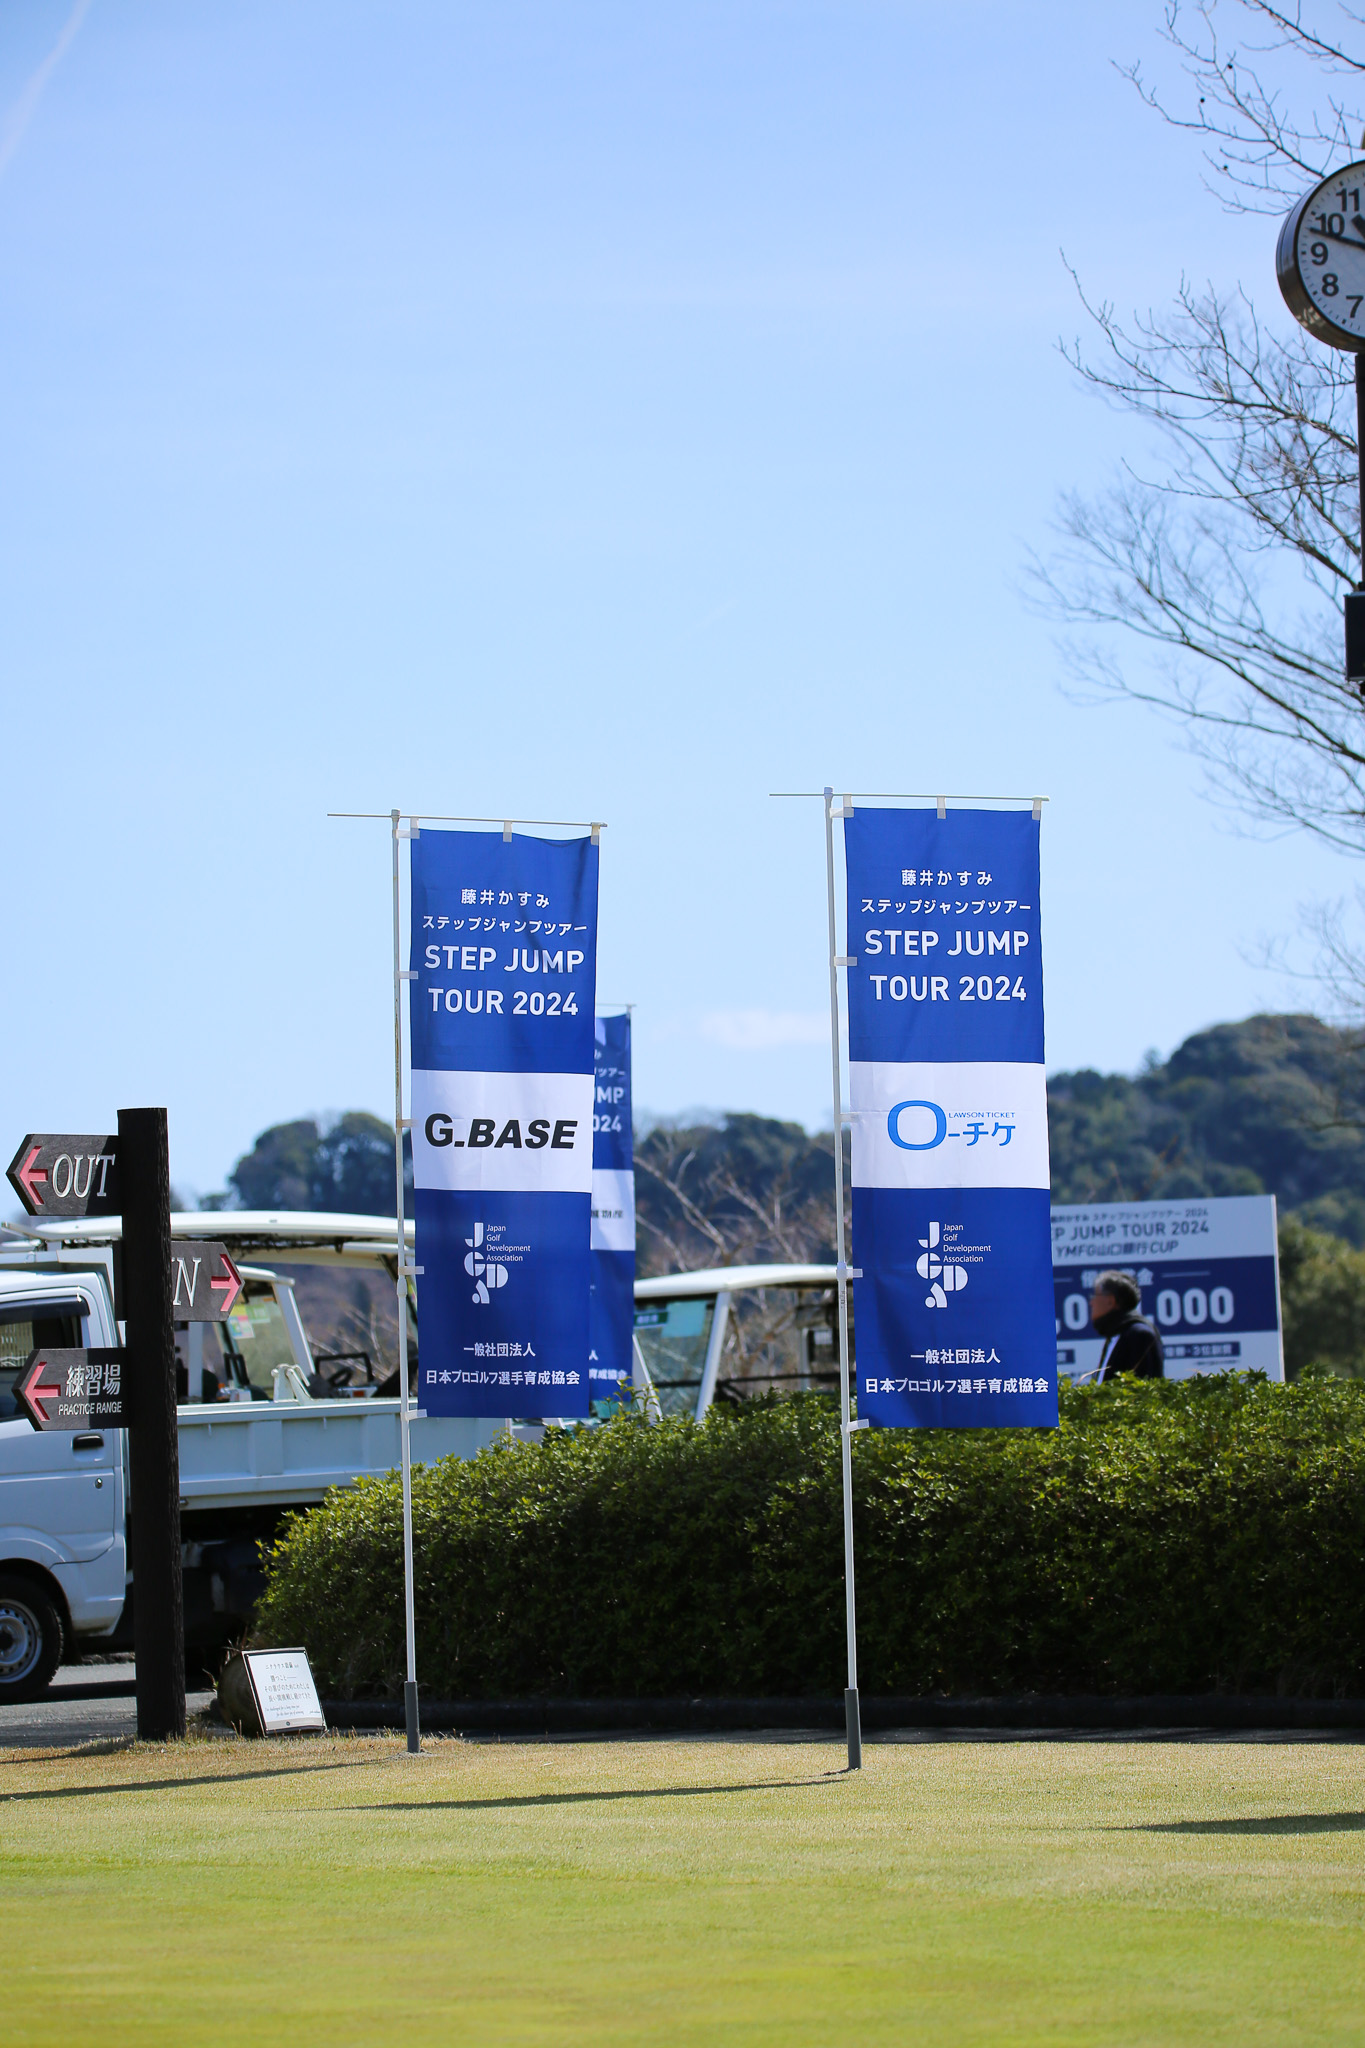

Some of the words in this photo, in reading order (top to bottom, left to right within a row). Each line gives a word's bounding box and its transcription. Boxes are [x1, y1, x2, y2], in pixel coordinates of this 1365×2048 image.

[1336, 187, 1360, 212] 11
[1315, 212, 1345, 238] 10
[1310, 241, 1329, 266] 9
[1321, 272, 1340, 297] 8
[1345, 294, 1364, 319] 7
[901, 869, 993, 887] 藤井かすみ
[460, 888, 550, 909] 藤井かすみ
[861, 898, 1031, 915] ステップジャンプツアー
[422, 915, 587, 937] ステップジャンプツアー
[864, 929, 939, 956] STEP
[946, 930, 1029, 956] JUMP
[424, 944, 497, 971] STEP
[503, 948, 585, 974] JUMP
[869, 975, 950, 1001] TOUR
[958, 975, 1027, 1001] 2024
[427, 987, 504, 1015] TOUR
[512, 990, 579, 1016] 2024
[595, 1085, 624, 1104] MP
[424, 1112, 578, 1150] G.BASE
[52, 1153, 116, 1198] OUT
[1185, 1207, 1209, 1218] 2024
[486, 1224, 507, 1233] Japan
[486, 1233, 501, 1242] Golf
[942, 1233, 959, 1242] Golf
[943, 1223, 964, 1233] Japan
[1070, 1224, 1116, 1241] JUMP
[1121, 1222, 1166, 1238] TOUR
[1171, 1220, 1209, 1236] 2024
[486, 1244, 531, 1253] Development
[486, 1254, 524, 1262] Association
[943, 1244, 992, 1254] Development
[942, 1254, 984, 1263] Association
[171, 1257, 202, 1307] N
[463, 1342, 536, 1358] 一般社団法人
[910, 1348, 1001, 1365] 一般社団法人
[65, 1363, 121, 1398] 練習場
[426, 1369, 581, 1386] 日本プロゴルフ選手育成協会
[865, 1377, 1049, 1394] 日本プロゴルフ選手育成協会
[58, 1402, 95, 1416] PRACTICE
[96, 1401, 123, 1414] RANGE
